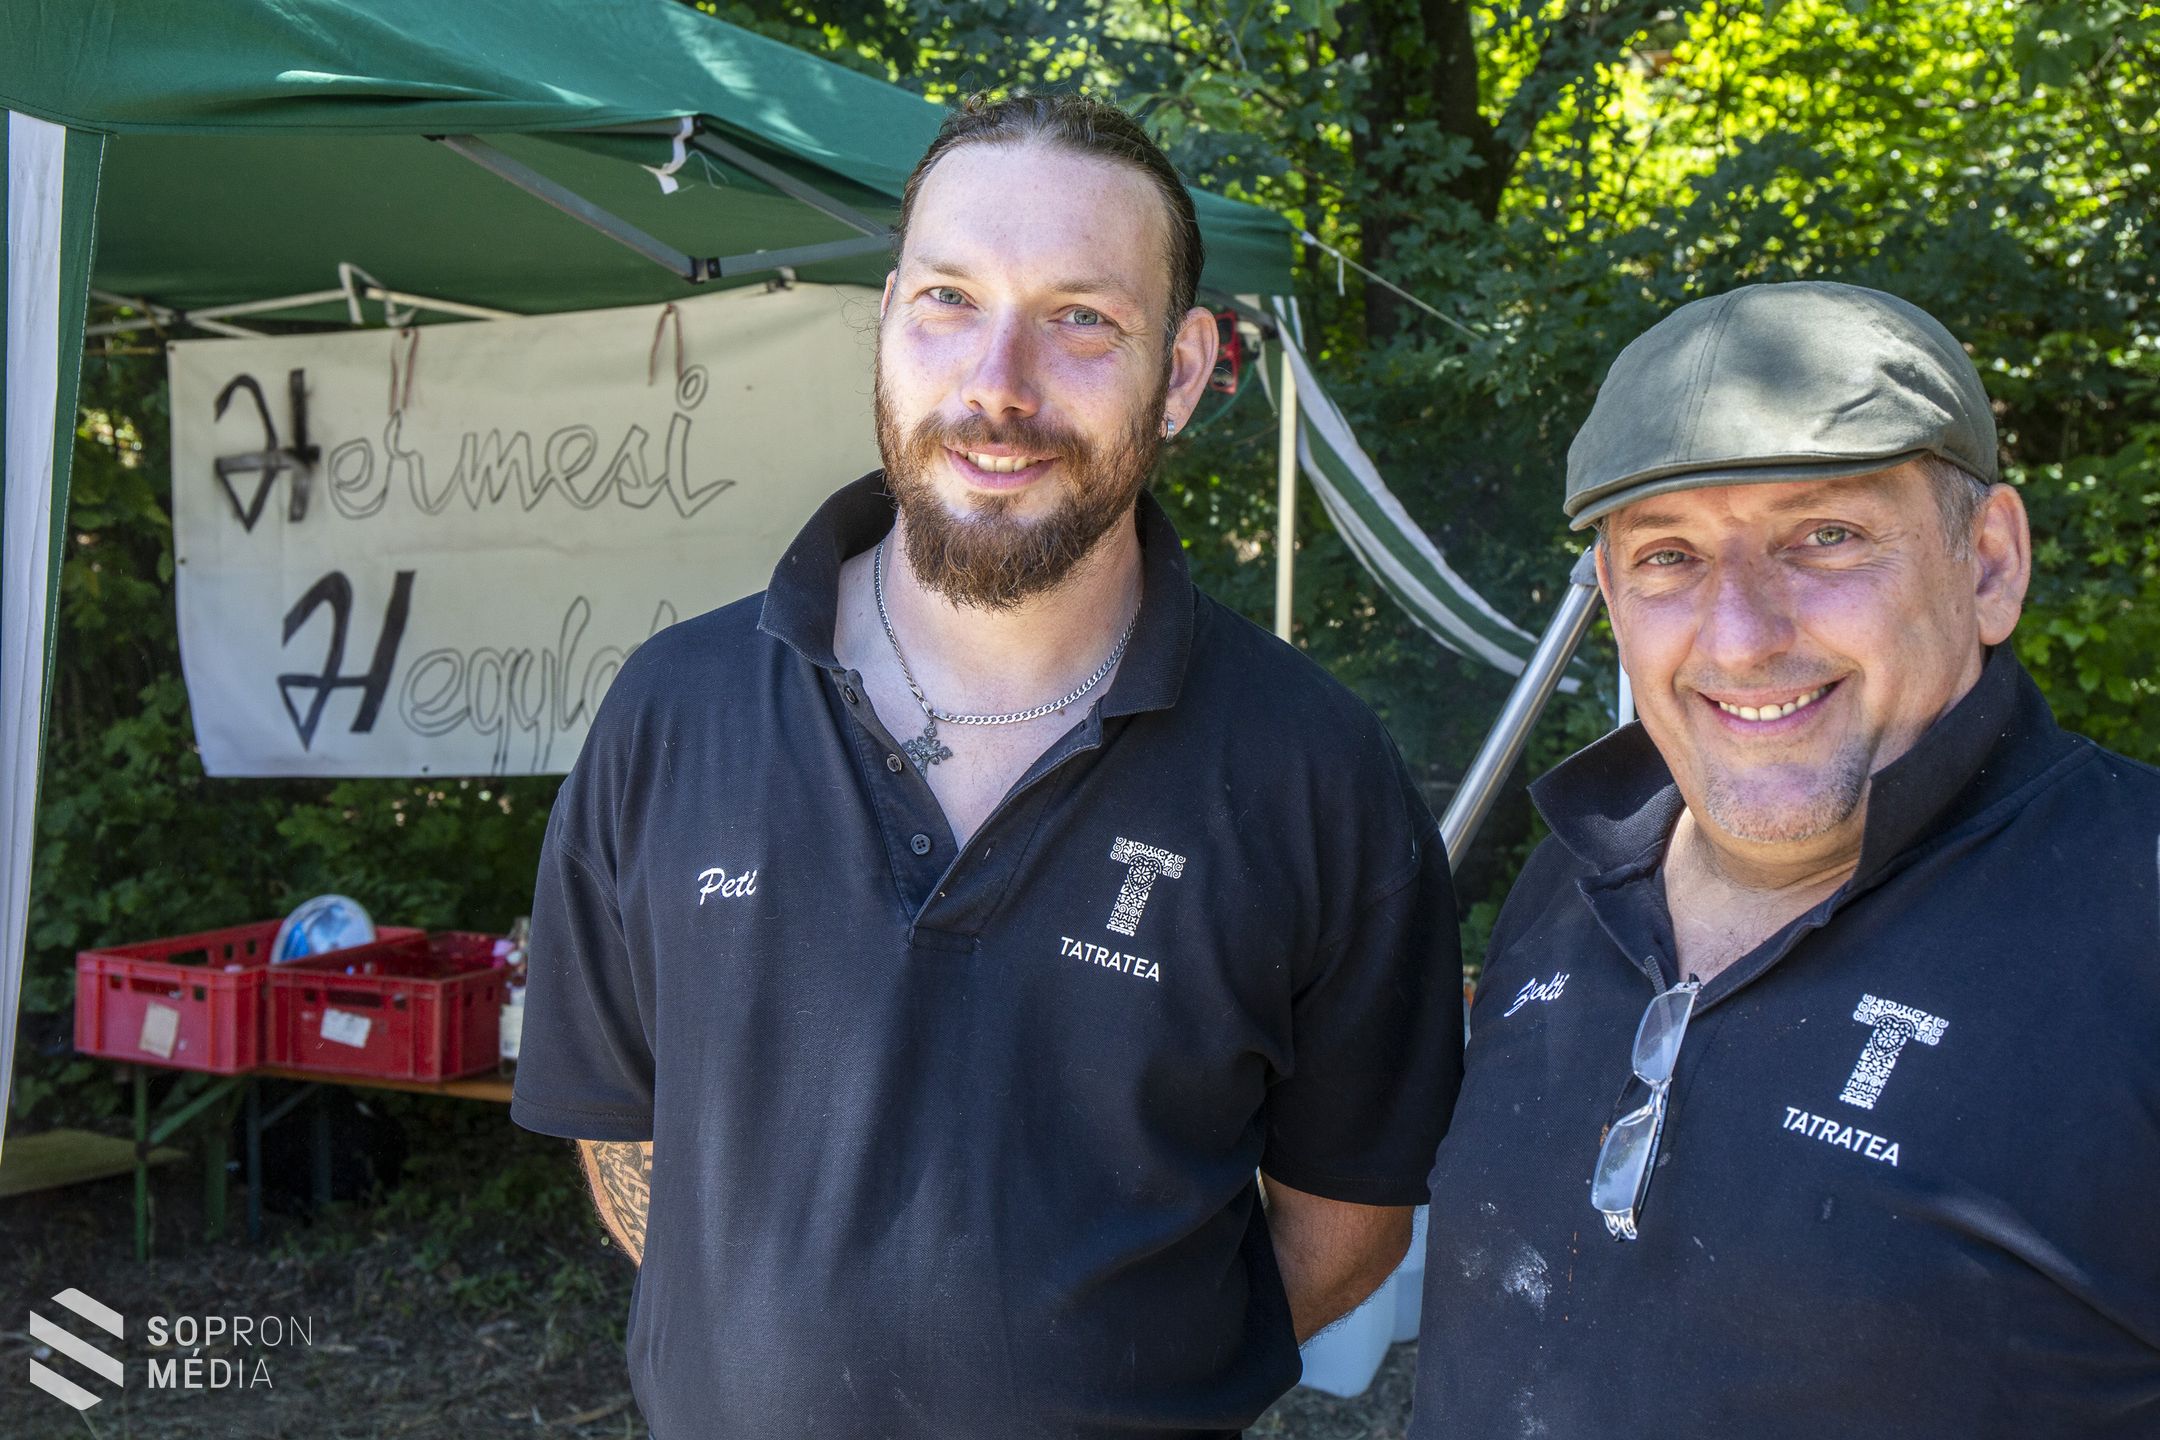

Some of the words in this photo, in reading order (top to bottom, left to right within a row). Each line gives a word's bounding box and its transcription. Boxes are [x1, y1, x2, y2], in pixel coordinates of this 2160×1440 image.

[698, 867, 758, 906] Peti
[1060, 936, 1161, 982] TATRATEA
[1783, 1107, 1901, 1167] TATRATEA
